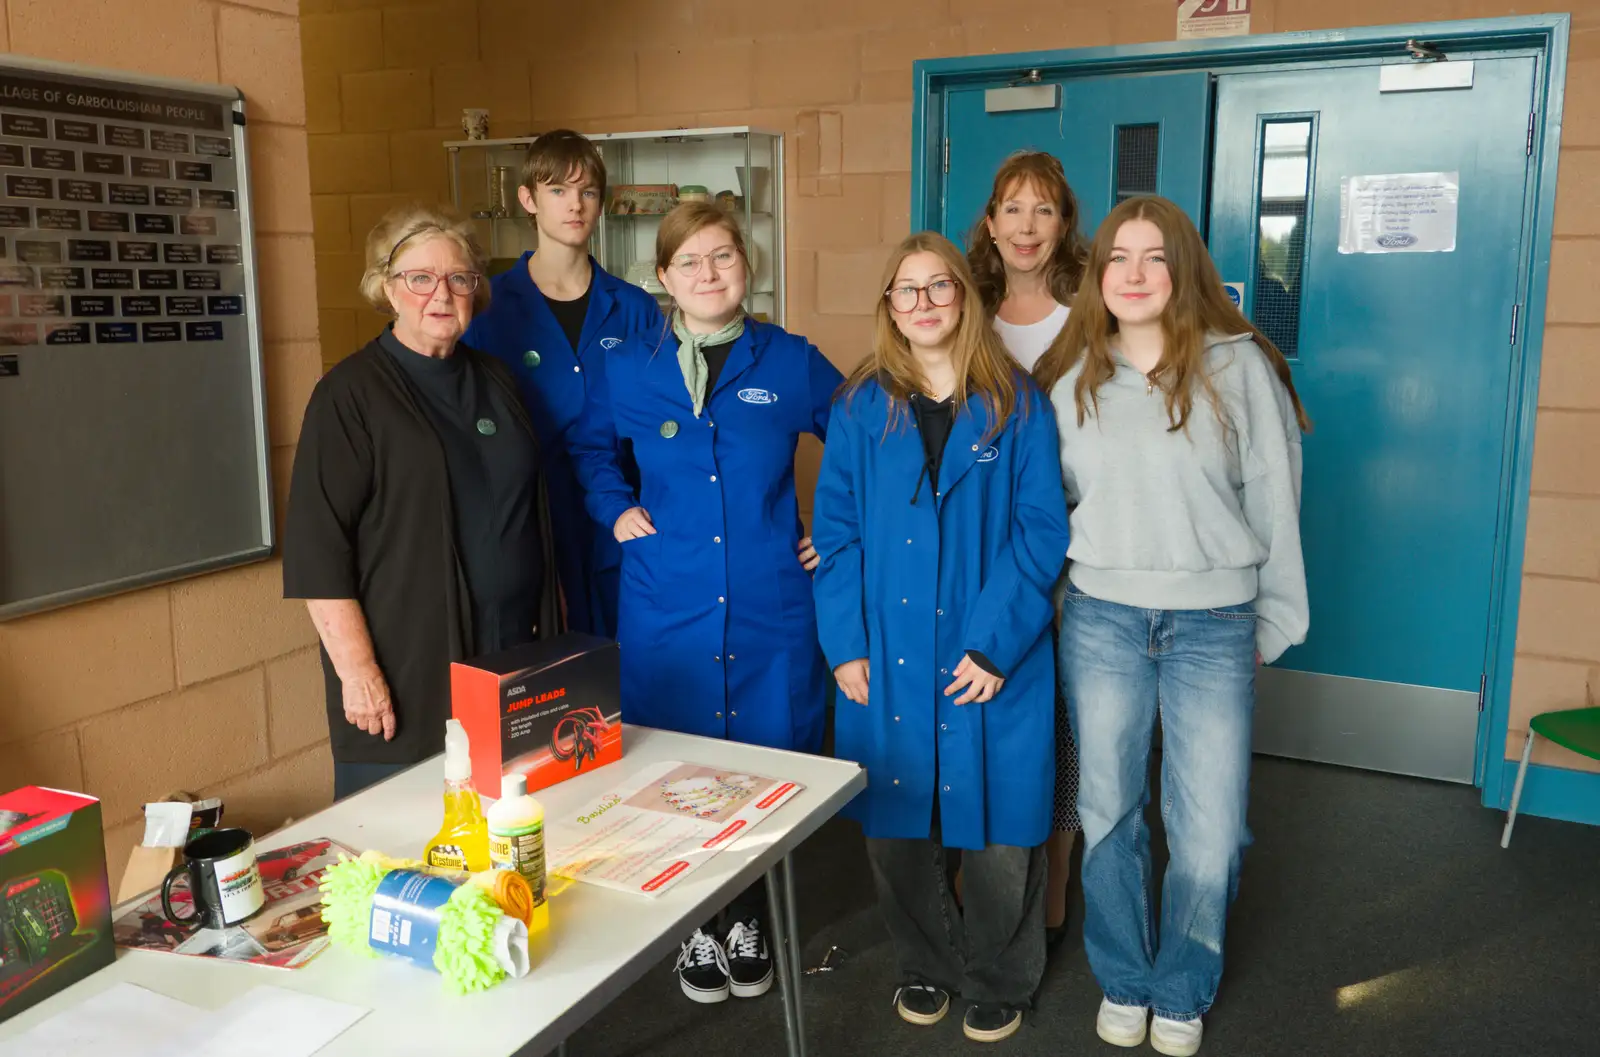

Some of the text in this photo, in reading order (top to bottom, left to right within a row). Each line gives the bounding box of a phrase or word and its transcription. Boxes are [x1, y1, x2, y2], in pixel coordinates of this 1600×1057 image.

[0, 85, 206, 121] LAGE OF GARBOLDISHAM PEOPLE
[745, 390, 769, 401] Ford
[507, 685, 526, 697] ASDA
[507, 688, 566, 713] JUMP LEADS
[518, 721, 532, 731] length
[432, 853, 462, 868] Prestone
